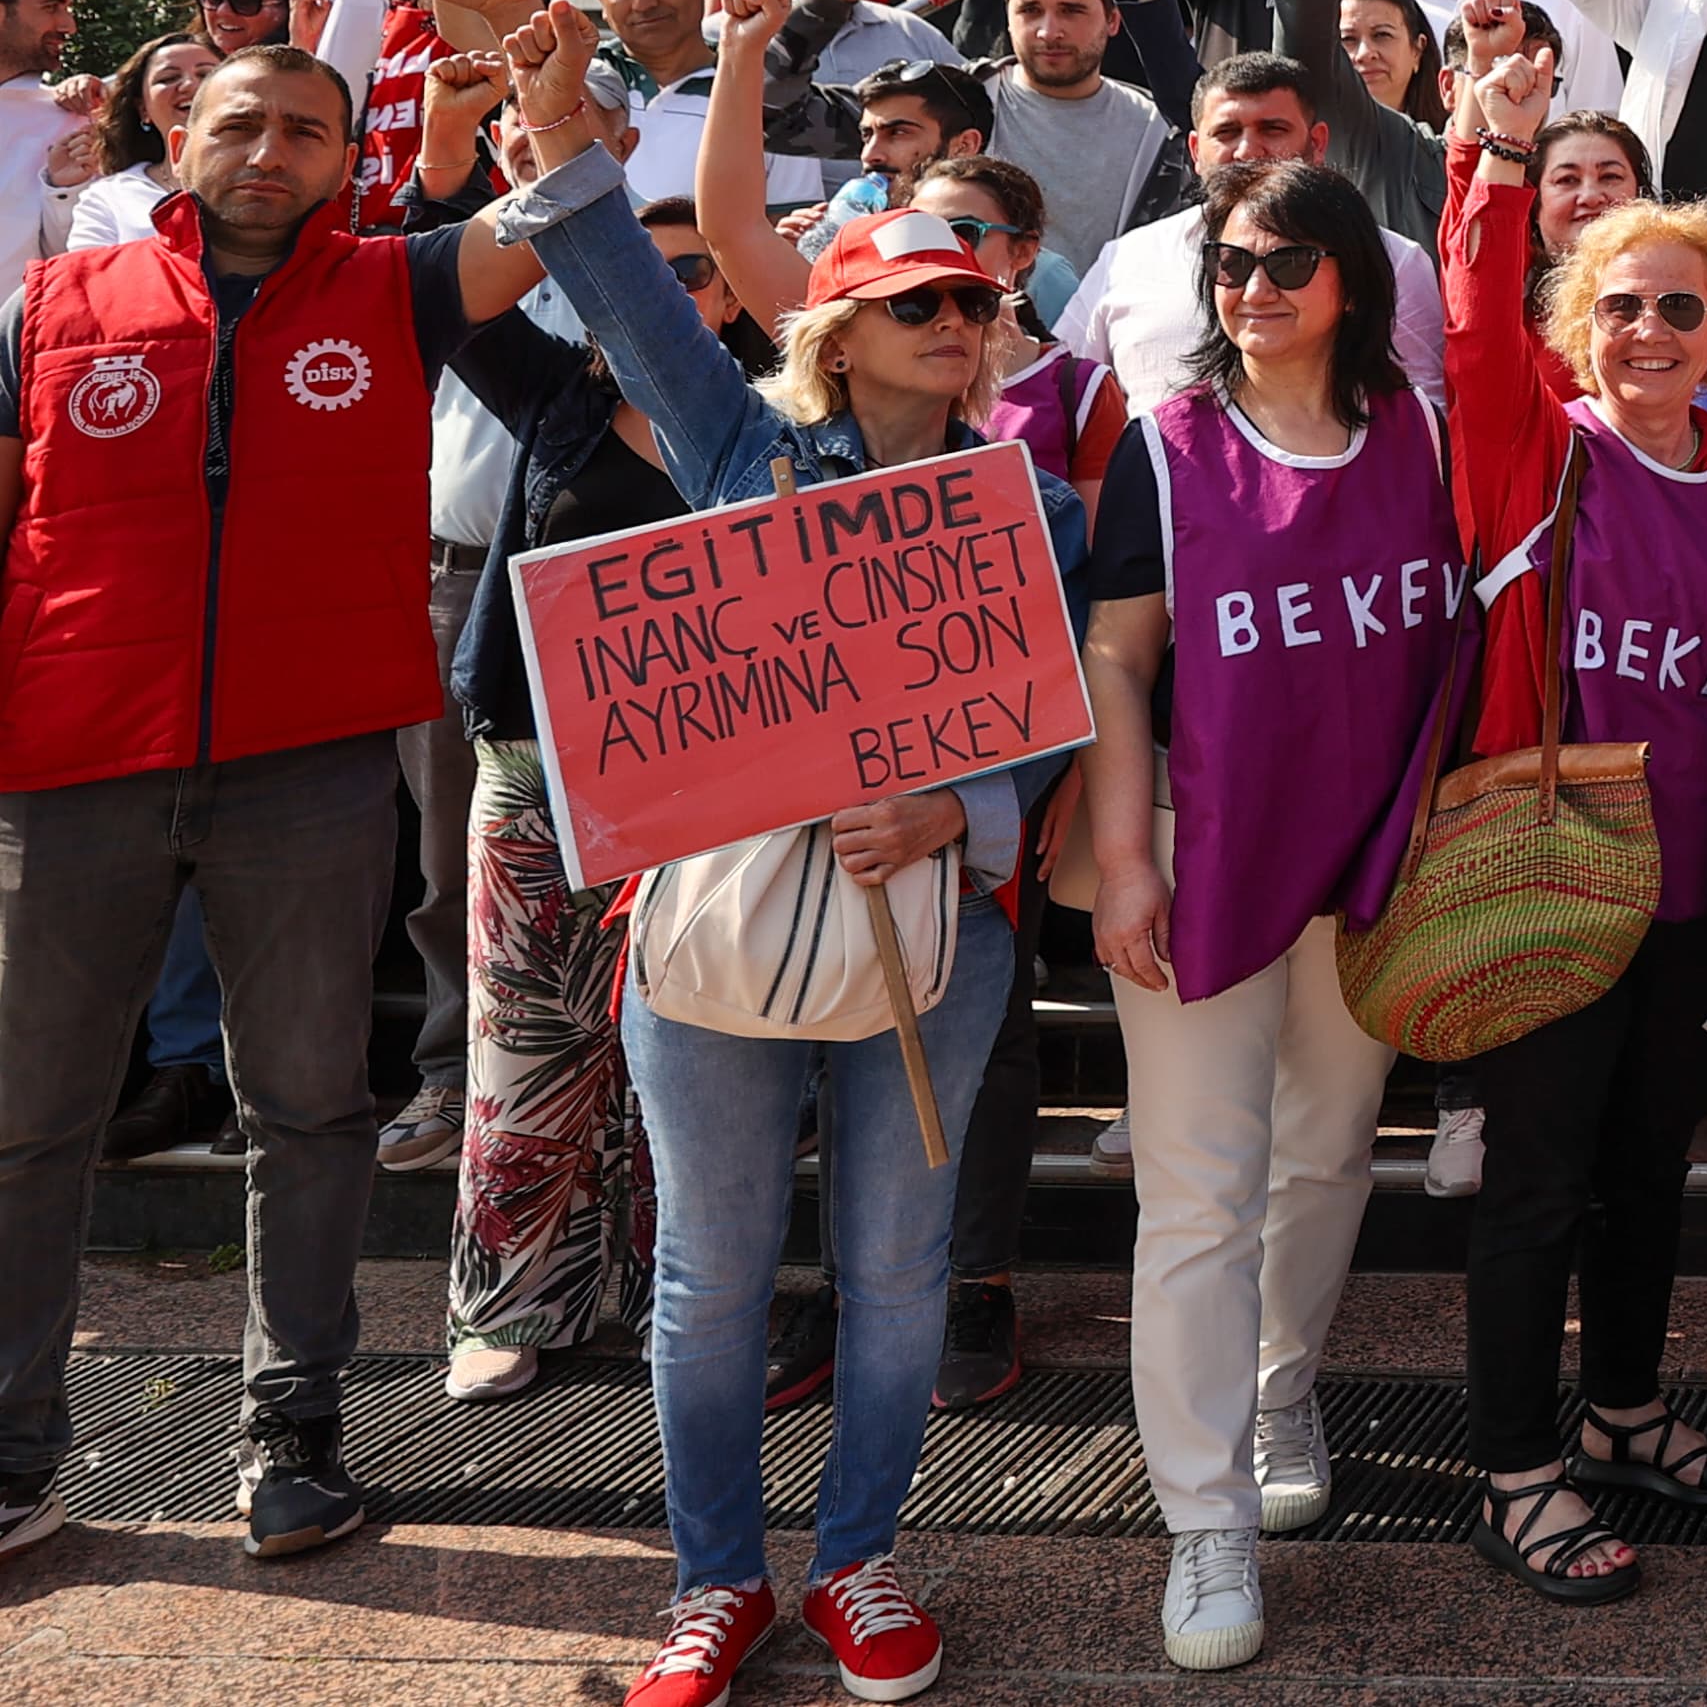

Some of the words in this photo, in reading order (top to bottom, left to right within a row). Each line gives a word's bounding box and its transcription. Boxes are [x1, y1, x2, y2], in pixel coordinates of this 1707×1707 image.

[574, 596, 758, 702] İNANÇ
[823, 521, 1027, 629] CİNSİYET
[586, 468, 981, 621] EĞİTİMDE
[1215, 558, 1469, 659] BEKEV
[598, 642, 862, 776] AYRIMINA
[896, 596, 1031, 690] SON
[849, 680, 1034, 790] BEKEV
